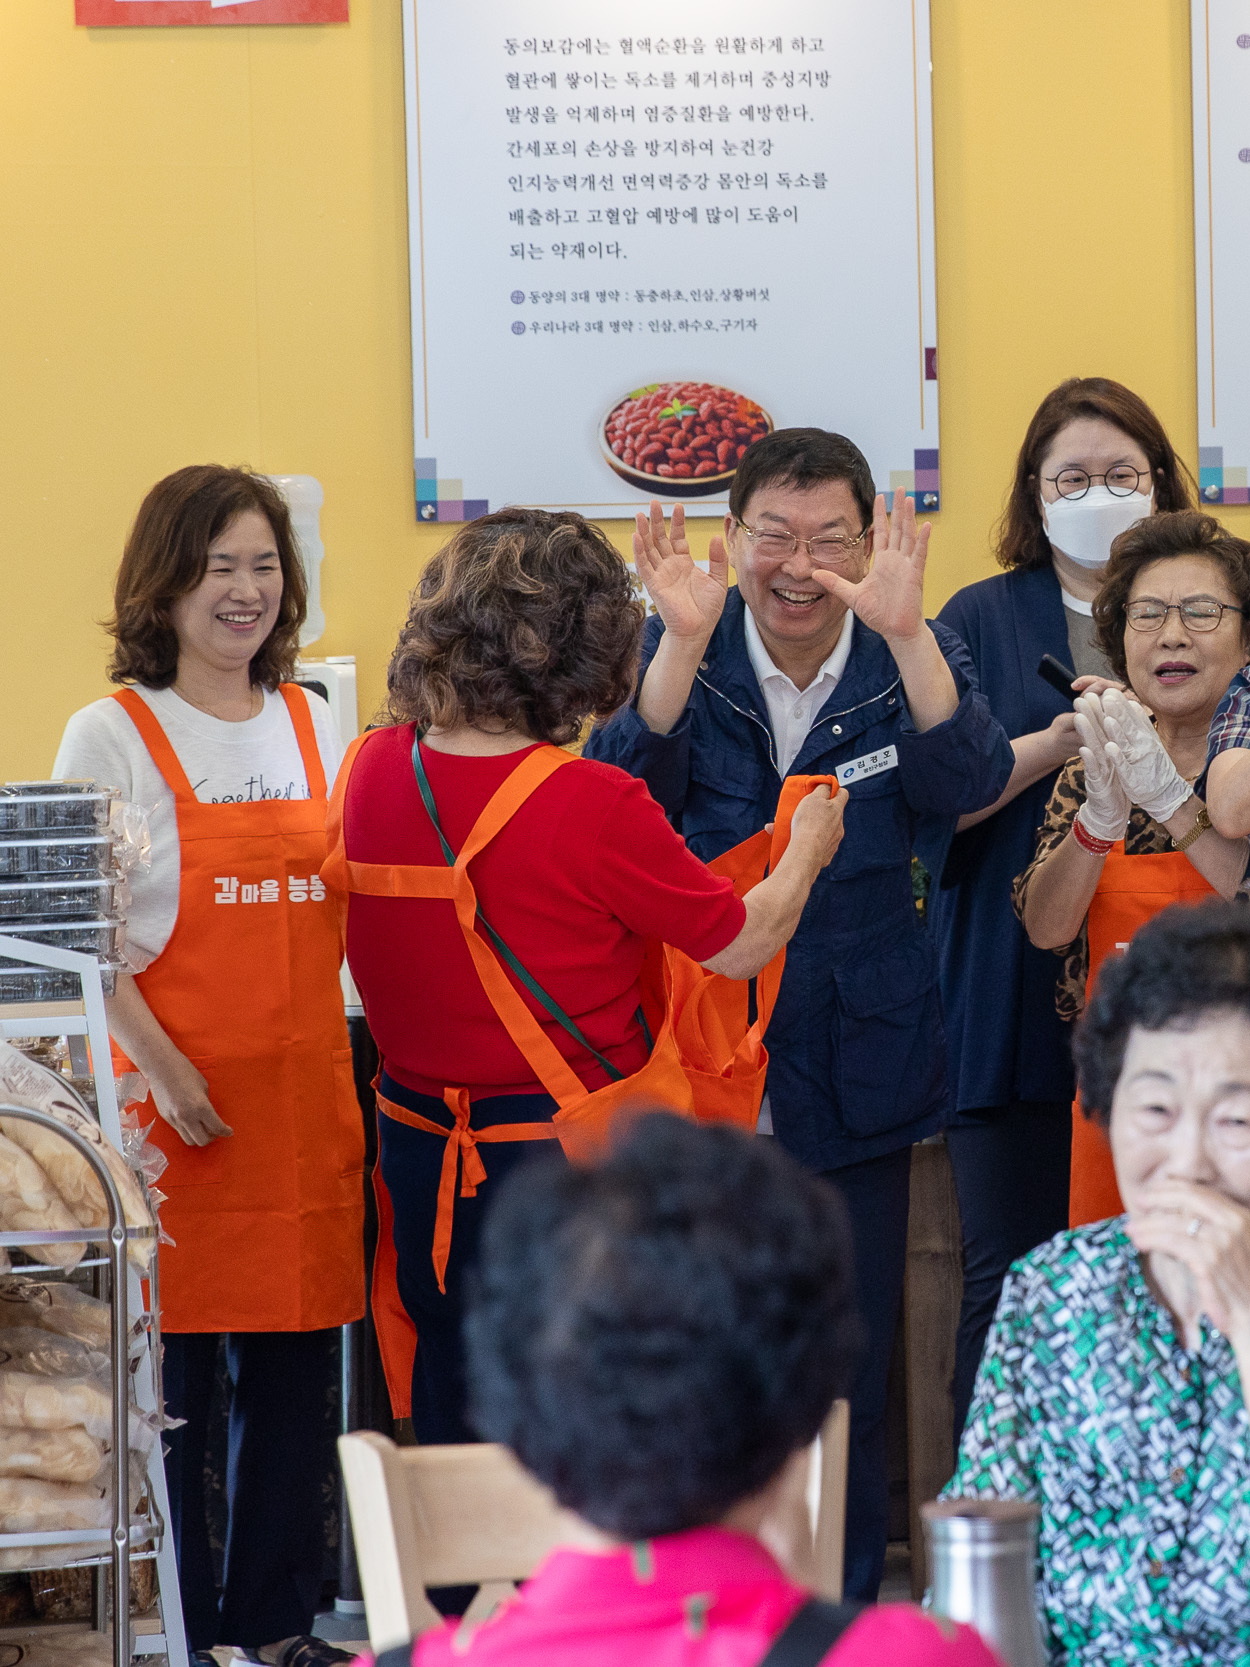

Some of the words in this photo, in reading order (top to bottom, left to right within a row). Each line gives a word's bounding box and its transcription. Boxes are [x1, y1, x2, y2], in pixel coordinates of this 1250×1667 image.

[503, 38, 610, 56] 동의보감에는
[619, 37, 706, 54] 혈액순환을
[715, 37, 782, 54] 원활하게
[791, 37, 824, 54] 하고
[505, 72, 557, 89] 혈관에
[625, 72, 677, 89] 독소를
[686, 70, 753, 88] 제거하며
[762, 70, 831, 88] 중성지방
[505, 105, 559, 124] 발생을
[566, 105, 635, 122] 억제하며
[644, 105, 732, 123] 염증질환을
[739, 104, 814, 121] 예방한다.
[507, 140, 576, 158] 간세포의
[585, 139, 637, 157] 손상을
[645, 139, 713, 157] 방지하여
[722, 138, 774, 157] 눈건강
[508, 174, 614, 192] 인지능력개선
[622, 173, 710, 190] 면역력증강
[717, 172, 768, 190] 몸안의
[776, 173, 828, 189] 독소를
[508, 208, 579, 226] 배출하고
[586, 208, 639, 225] 고혈압
[646, 207, 698, 225] 예방에
[705, 206, 739, 224] 많이
[747, 206, 798, 223] 도움이
[510, 242, 544, 260] 되는
[551, 241, 627, 260] 약재이다.
[528, 290, 566, 304] 동양의
[571, 290, 590, 302] 3대
[595, 290, 620, 303] 명약
[530, 321, 580, 334] 우리나라
[585, 320, 603, 333] 3대
[609, 319, 633, 334] 명약
[214, 876, 280, 904] 감마을
[288, 874, 326, 903] 능동
